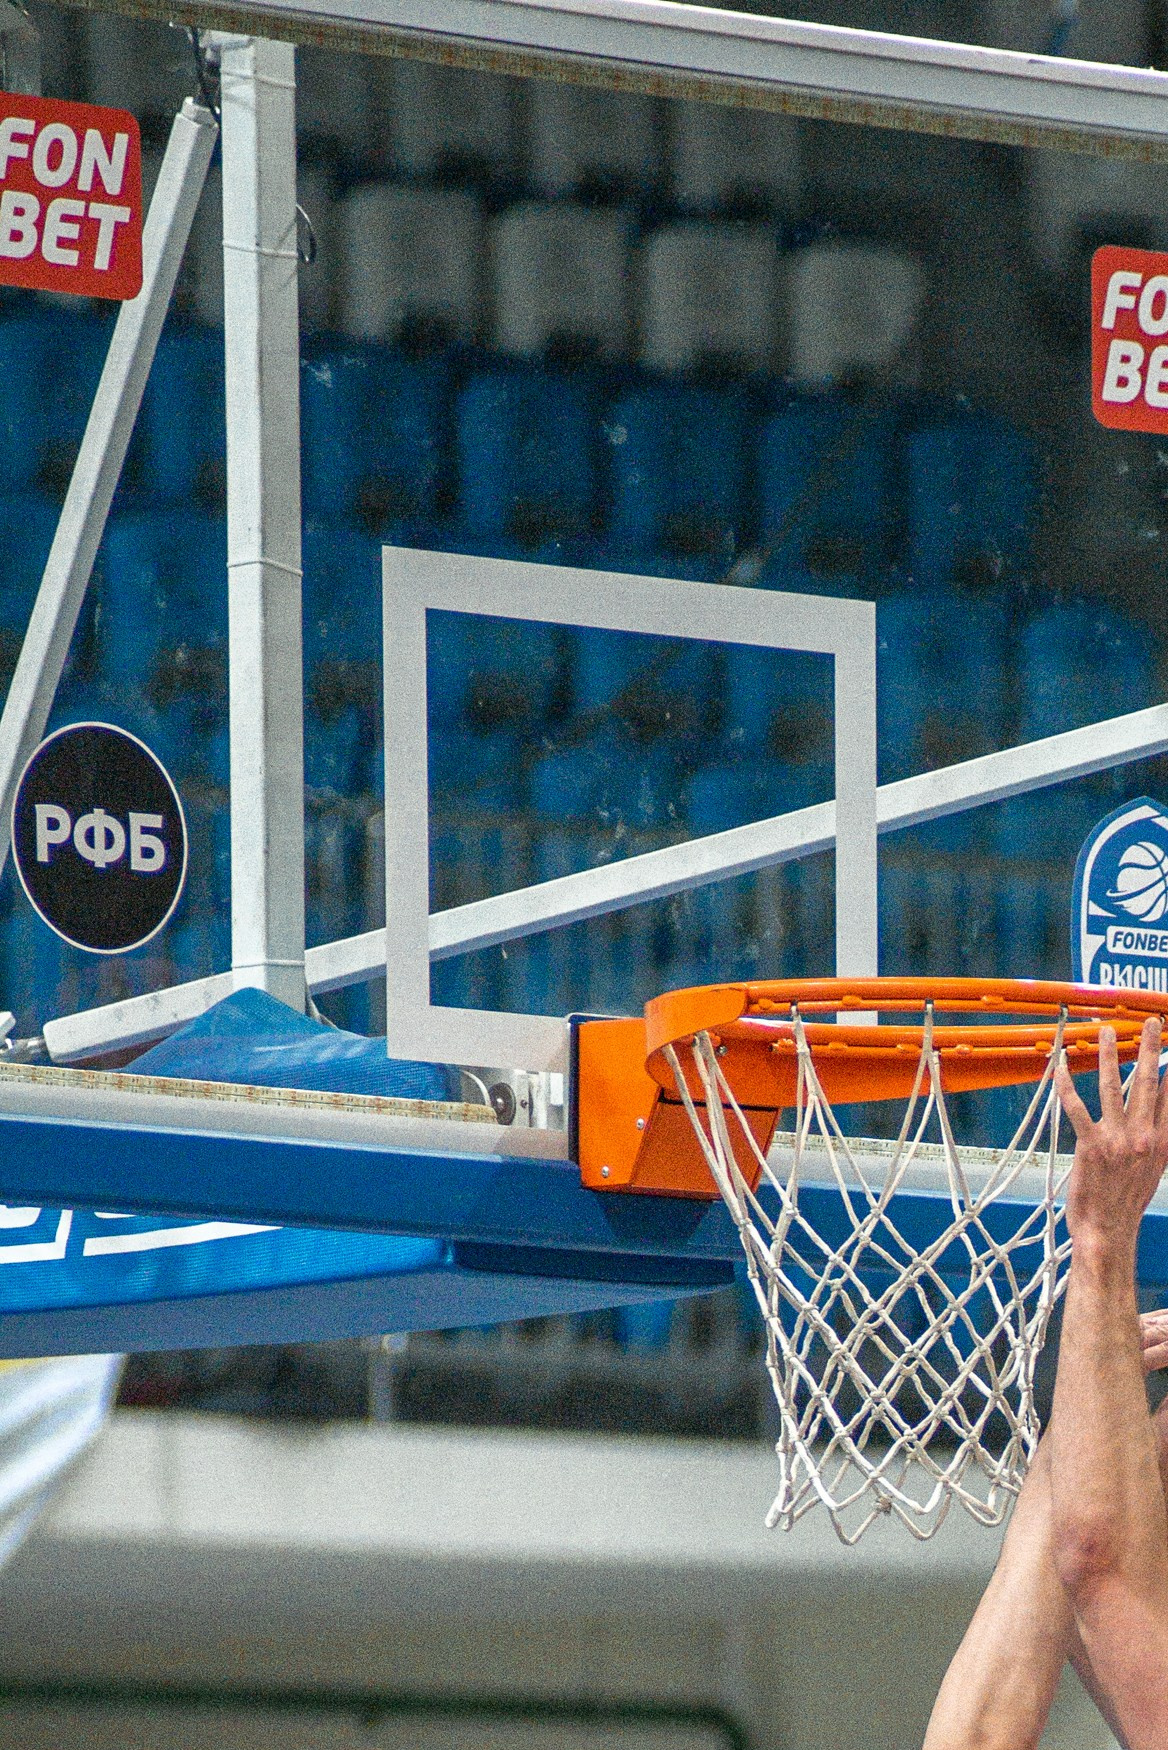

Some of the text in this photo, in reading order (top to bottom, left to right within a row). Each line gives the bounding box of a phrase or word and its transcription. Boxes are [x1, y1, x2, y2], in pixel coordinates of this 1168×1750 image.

[0, 117, 130, 195] FON
[0, 190, 131, 270] BET
[34, 804, 166, 872] РФБ
